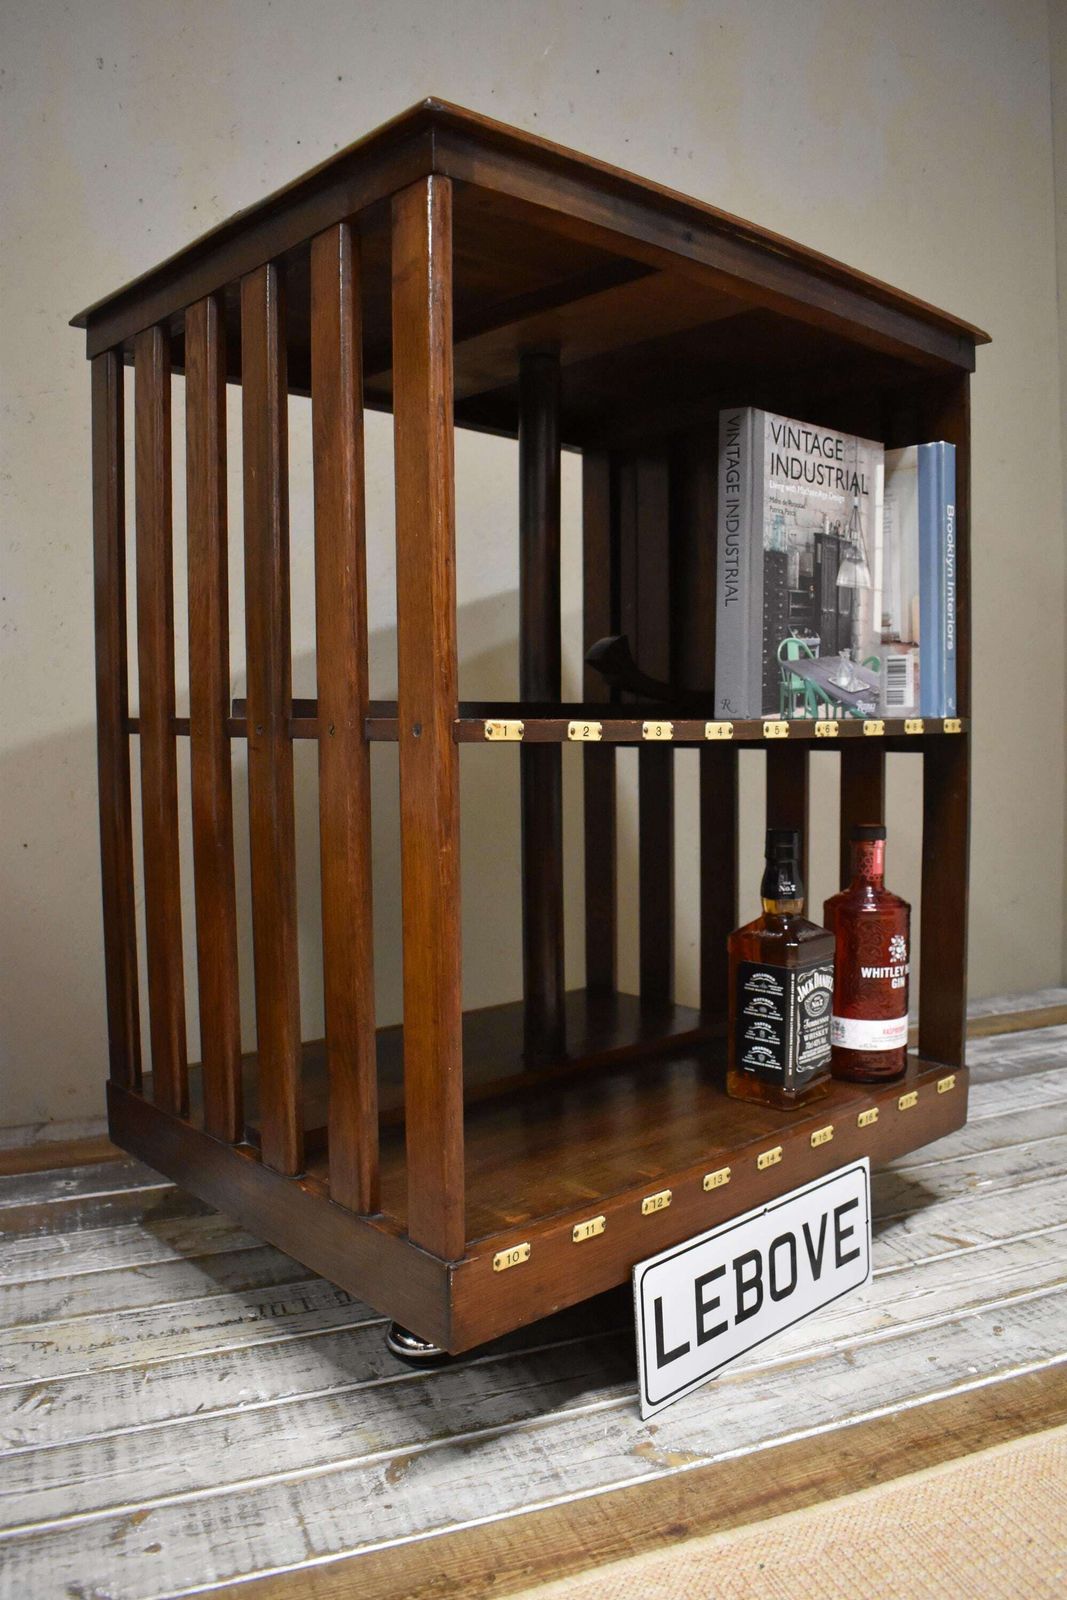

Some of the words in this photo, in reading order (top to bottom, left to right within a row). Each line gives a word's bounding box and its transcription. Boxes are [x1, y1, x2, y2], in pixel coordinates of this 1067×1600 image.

[770, 421, 844, 462] VINTAGE
[726, 415, 741, 494] VINTAGE
[770, 452, 870, 496] INDUSTRIAL
[945, 504, 956, 578] Brooklyn
[725, 499, 740, 607] INDUSTRIAL
[945, 581, 956, 650] Interiors
[582, 726, 590, 737] 2
[655, 726, 662, 737] 3
[717, 726, 724, 736] 4
[774, 725, 780, 735] 5
[825, 724, 830, 734] 6
[861, 965, 905, 979] WHITLEY
[891, 977, 906, 989] GIN
[797, 977, 815, 1003] JACK
[803, 1027, 829, 1042] WHISKEY
[865, 1113, 873, 1123] 16
[817, 1132, 827, 1143] 15
[766, 1153, 776, 1165] 14
[712, 1174, 723, 1185] 13
[650, 1196, 663, 1209] 12
[585, 1224, 596, 1236] 11
[506, 1250, 520, 1265] 10
[653, 1197, 861, 1370] LEBOVE
